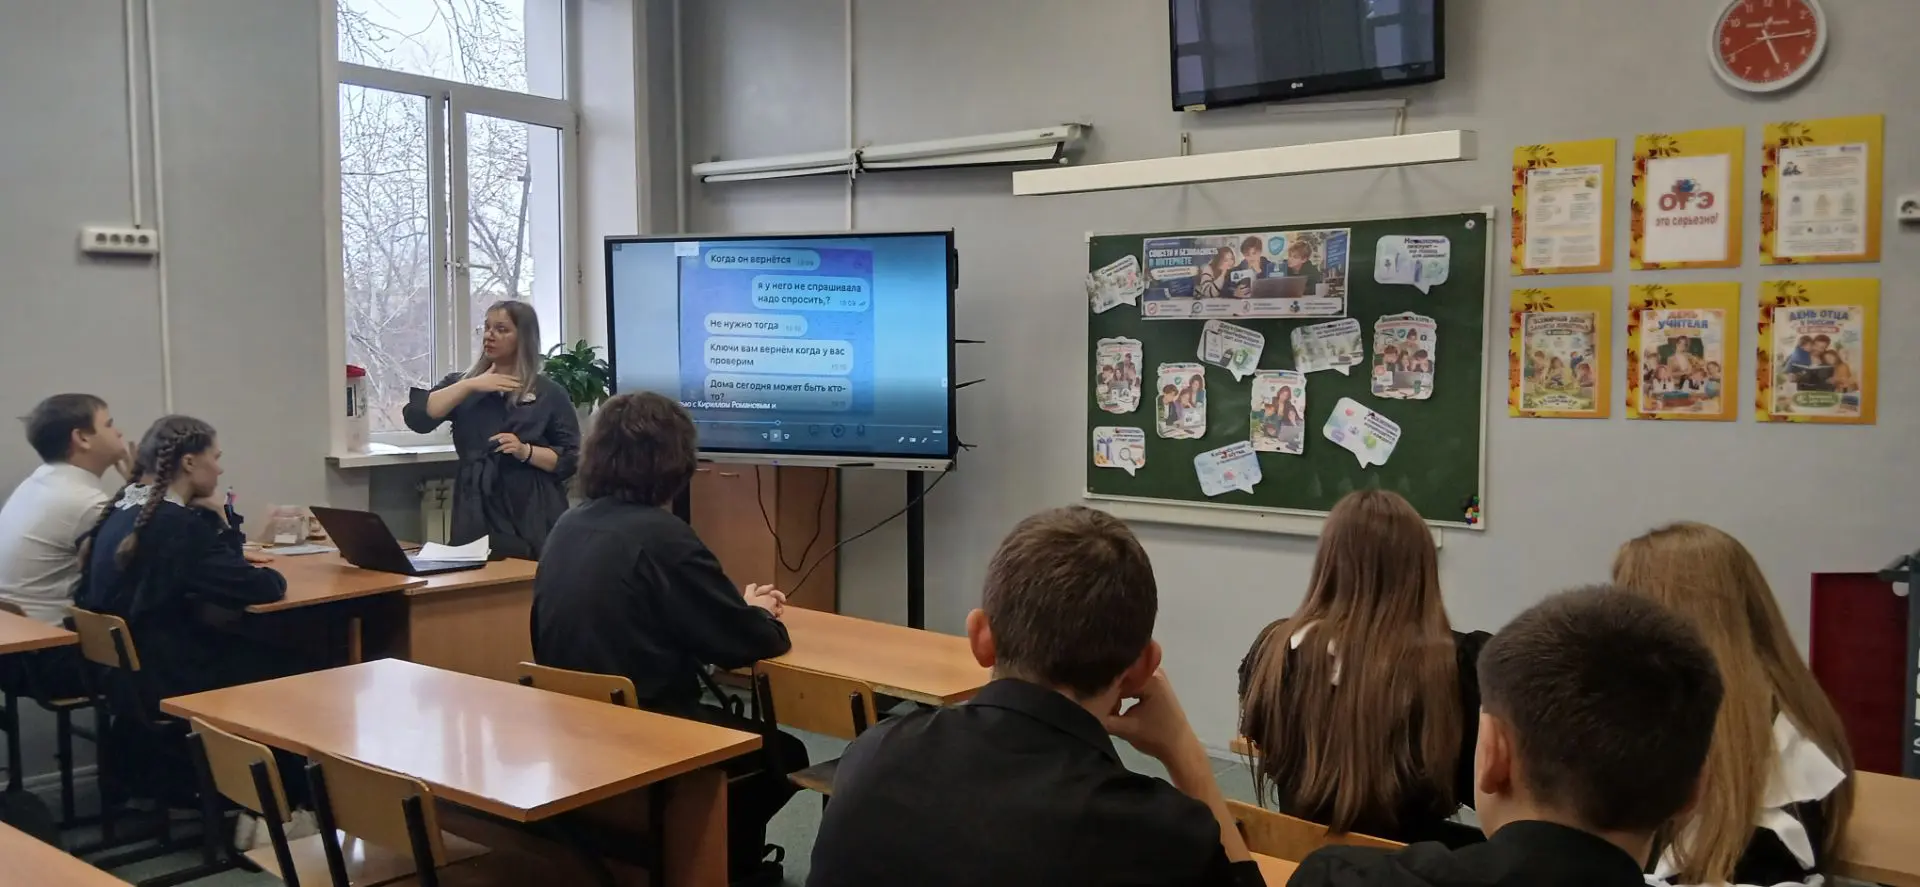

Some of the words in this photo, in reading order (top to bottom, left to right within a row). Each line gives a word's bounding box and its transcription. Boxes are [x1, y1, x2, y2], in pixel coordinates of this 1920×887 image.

[711, 255, 736, 265] Когда
[750, 255, 791, 265] вернётся
[765, 282, 771, 291] у
[772, 282, 793, 290] него
[807, 283, 862, 293] спрашивала
[758, 296, 779, 304] надо
[710, 320, 721, 328] Не
[723, 321, 752, 330] нужно
[754, 321, 779, 330] тогда
[710, 343, 739, 353] Ключи
[760, 344, 794, 354] вернём
[795, 347, 821, 356] когда
[822, 348, 828, 357] у
[710, 357, 754, 367] проверим
[710, 379, 734, 390] Дома
[736, 381, 771, 391] сегодня
[773, 383, 802, 391] может
[804, 382, 826, 392] быть
[827, 384, 846, 392] кто-
[710, 392, 725, 401] то?
[697, 400, 731, 410] Кириллом
[731, 400, 770, 410] Романовым
